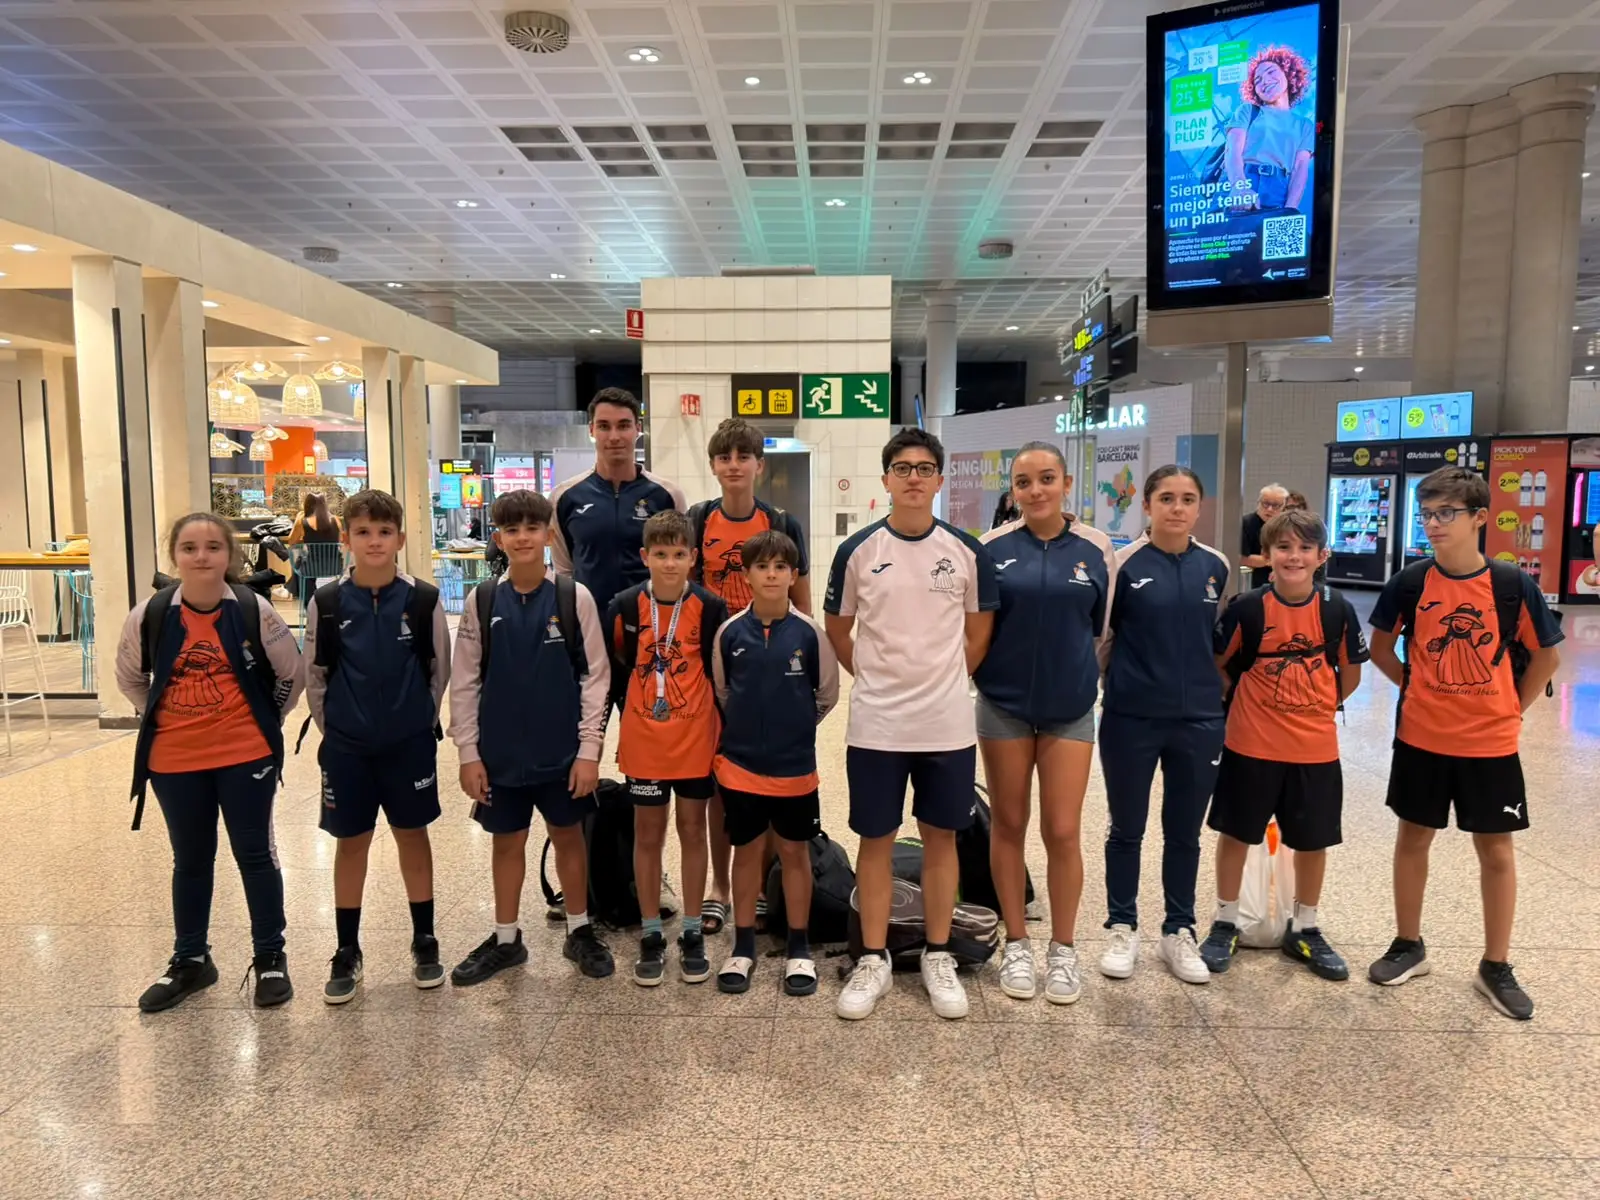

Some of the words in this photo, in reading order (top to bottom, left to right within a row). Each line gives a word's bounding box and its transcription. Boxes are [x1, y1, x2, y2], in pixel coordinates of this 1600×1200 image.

[1176, 91, 1193, 106] 25
[1175, 117, 1208, 132] PLAN
[1175, 129, 1205, 144] PLUS
[1170, 181, 1231, 197] Siempre
[1235, 178, 1253, 189] es
[1170, 198, 1213, 213] mejor
[1217, 192, 1259, 207] tener
[1170, 216, 1188, 228] un
[1192, 211, 1229, 229] plan.
[1097, 451, 1138, 463] BARCELONA
[1494, 446, 1513, 454] PICK
[1513, 445, 1537, 453] YOUR
[951, 480, 974, 489] DESIGN
[975, 479, 1011, 489] BARCELON
